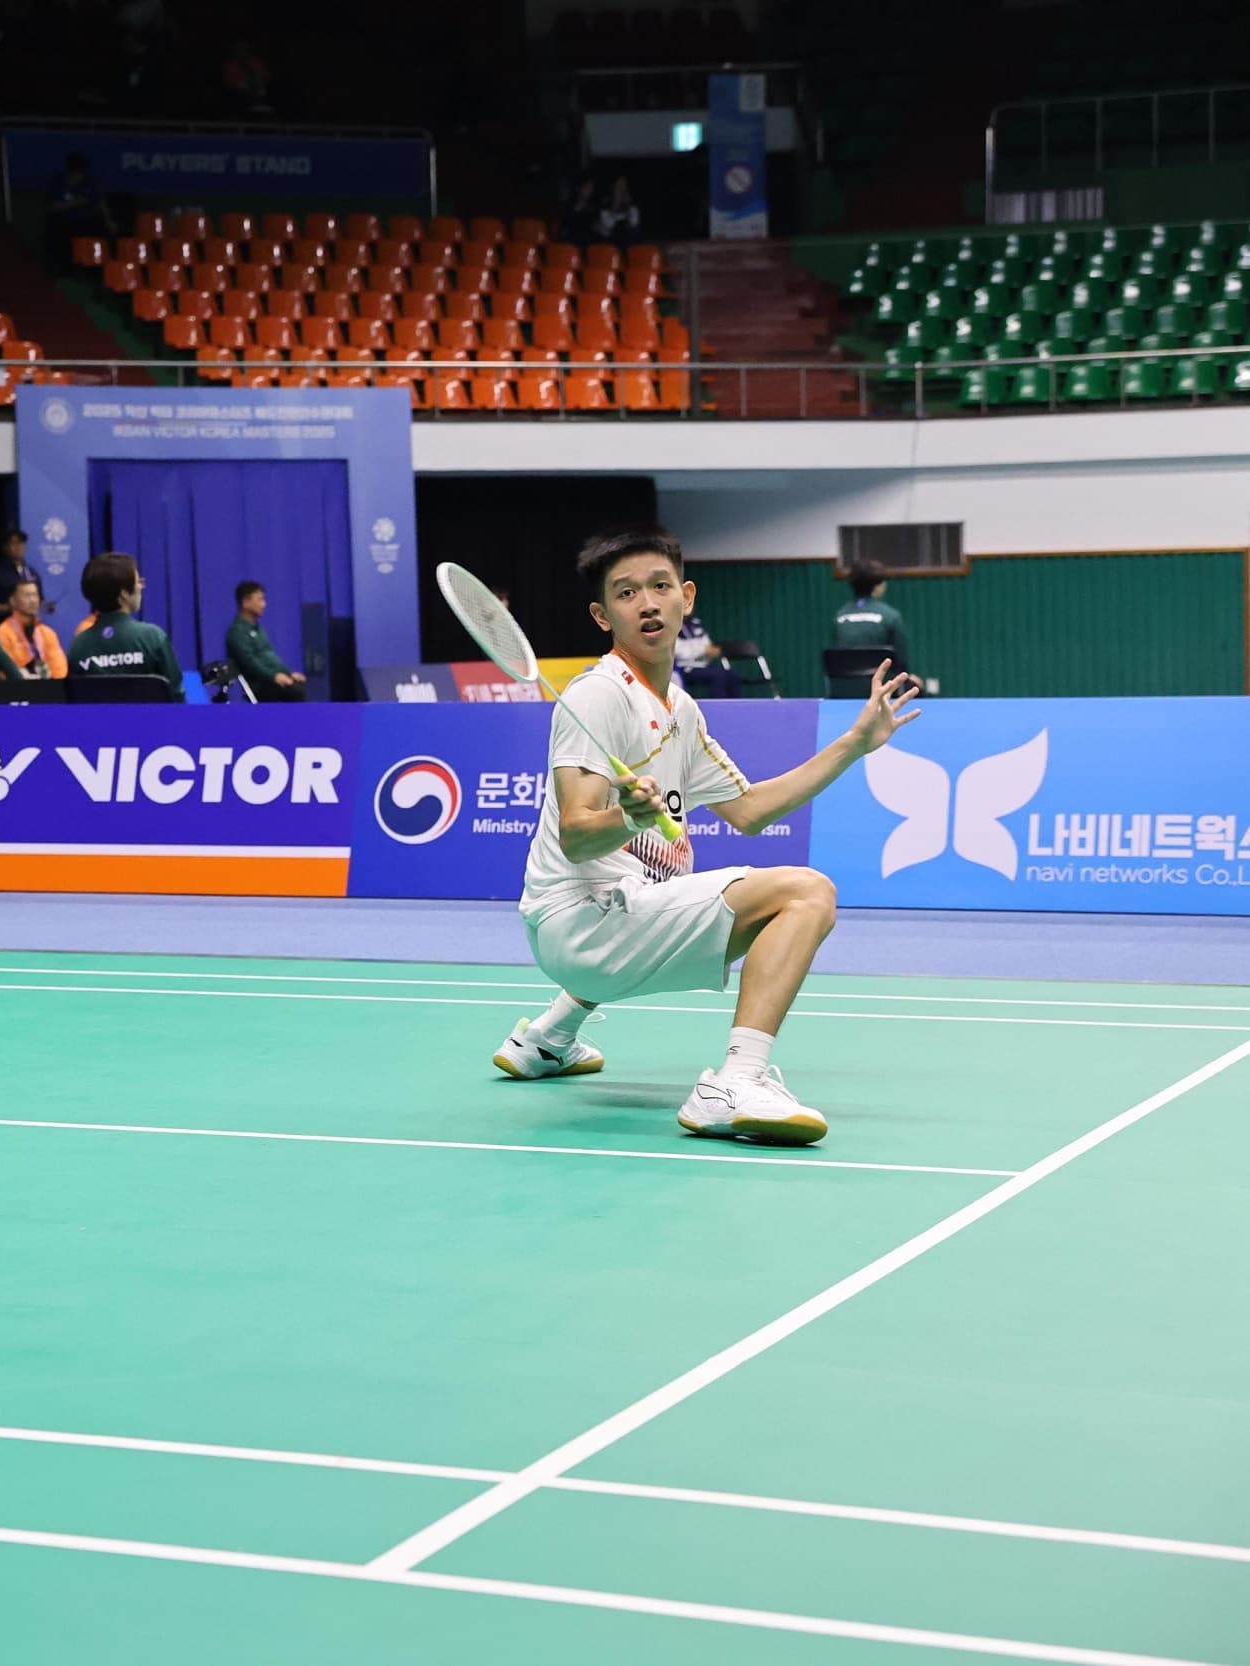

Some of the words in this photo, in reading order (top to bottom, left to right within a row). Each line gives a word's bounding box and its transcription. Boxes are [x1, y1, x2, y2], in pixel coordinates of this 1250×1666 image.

[236, 154, 312, 176] STAND
[90, 651, 144, 668] VICTOR
[55, 745, 343, 805] VICTOR
[472, 818, 537, 837] Ministry
[687, 820, 720, 836] and
[1026, 862, 1074, 883] navi
[1079, 862, 1189, 886] networks
